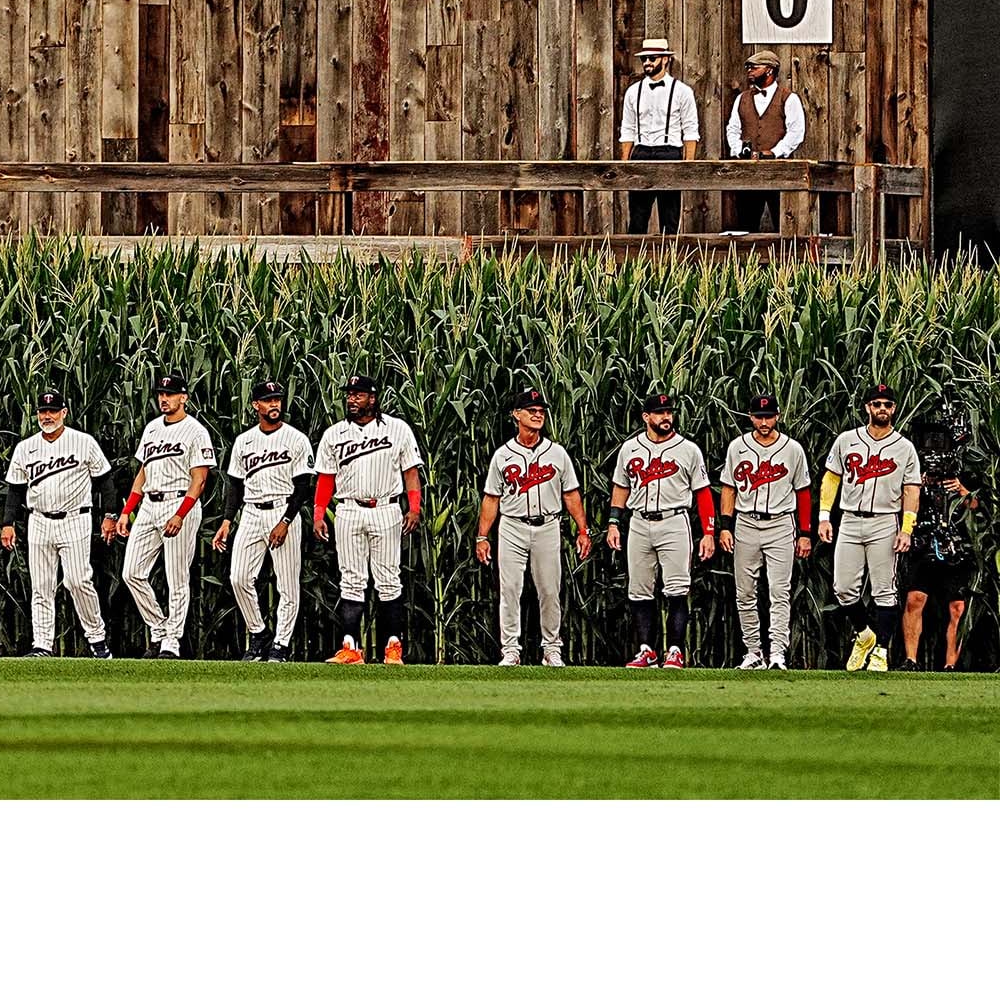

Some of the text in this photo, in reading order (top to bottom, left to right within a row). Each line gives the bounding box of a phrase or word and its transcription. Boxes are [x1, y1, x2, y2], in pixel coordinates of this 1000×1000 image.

[162, 377, 171, 387] T
[350, 376, 360, 386] T
[266, 382, 275, 392] T
[878, 384, 887, 393] P
[44, 393, 54, 403] T
[531, 391, 539, 400] P
[659, 395, 668, 405] P
[760, 398, 768, 408] P
[143, 440, 184, 467] Twins
[335, 436, 392, 469] Twins
[242, 449, 292, 479] Twins
[25, 454, 79, 488] Twins
